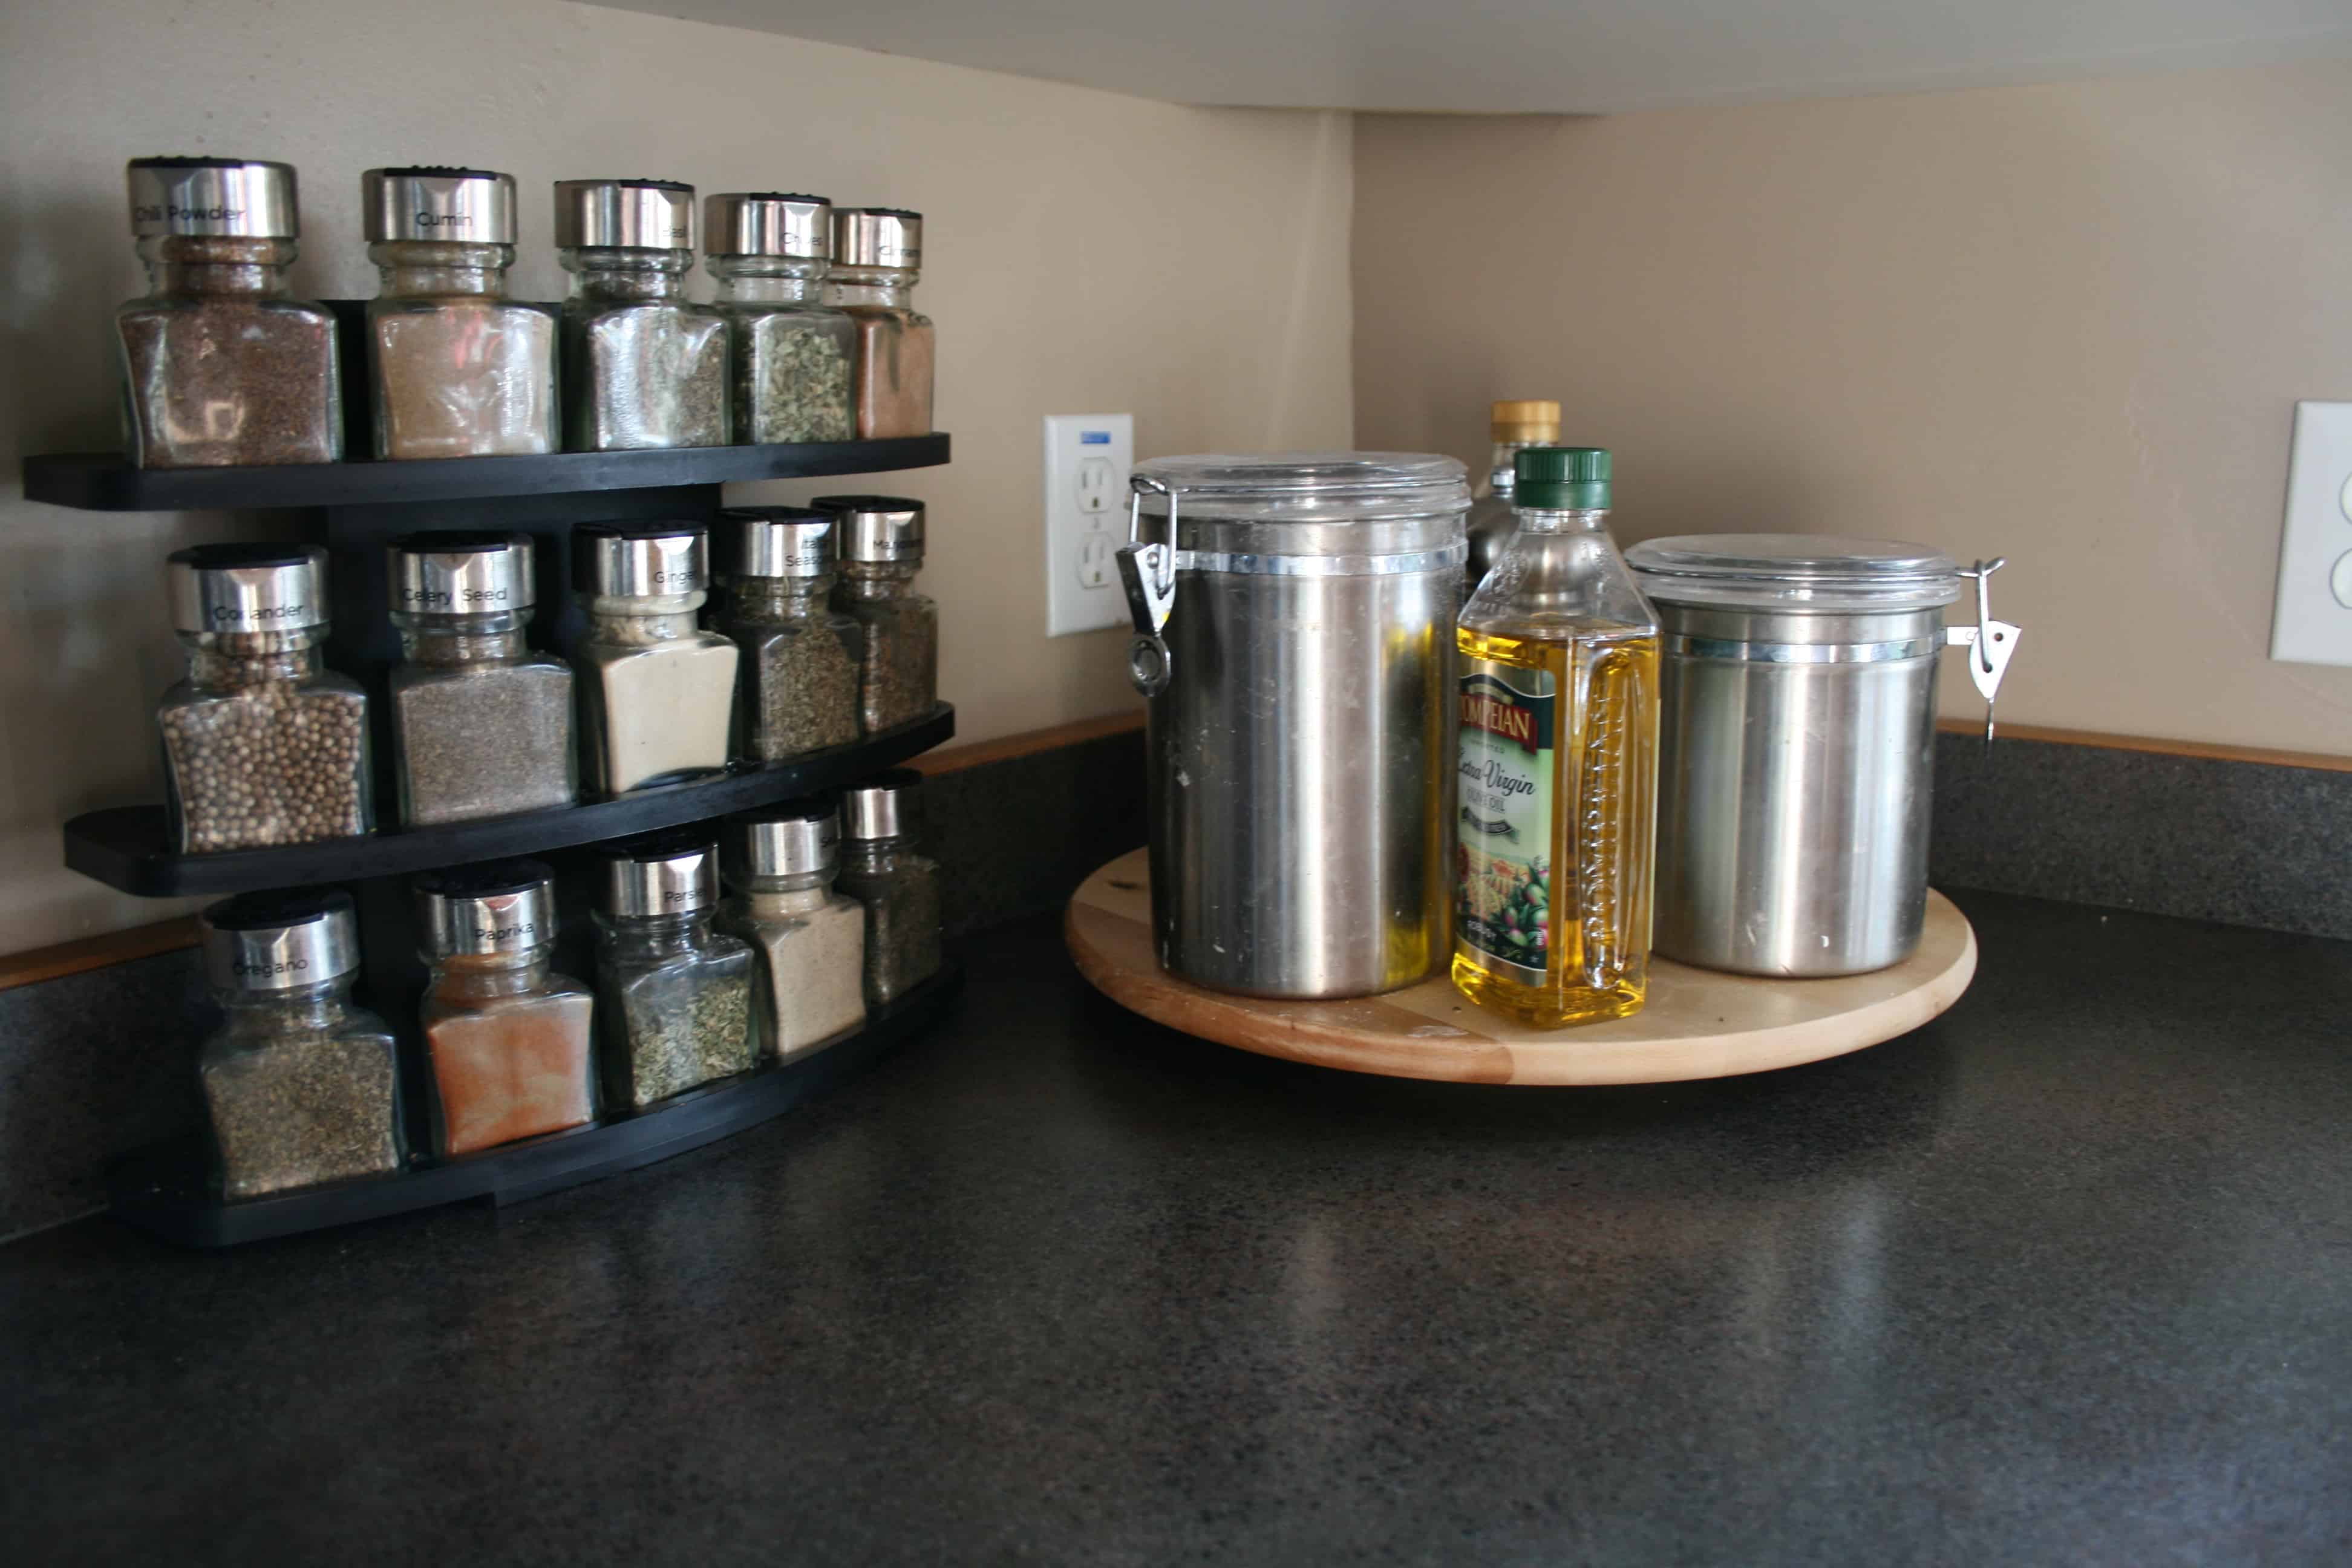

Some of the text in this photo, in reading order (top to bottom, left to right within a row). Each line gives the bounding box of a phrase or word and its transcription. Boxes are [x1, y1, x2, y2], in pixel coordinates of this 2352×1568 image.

[167, 203, 246, 221] Powder
[416, 212, 473, 226] Cumin
[779, 232, 823, 247] Ches
[655, 570, 697, 585] Gnge
[403, 587, 508, 606] Celery Seed
[215, 603, 304, 621] Coander
[1461, 694, 1531, 741] OMPEIAN
[1482, 759, 1537, 797] Virgin
[474, 922, 534, 940] Paprika
[233, 958, 309, 978] Oregano
